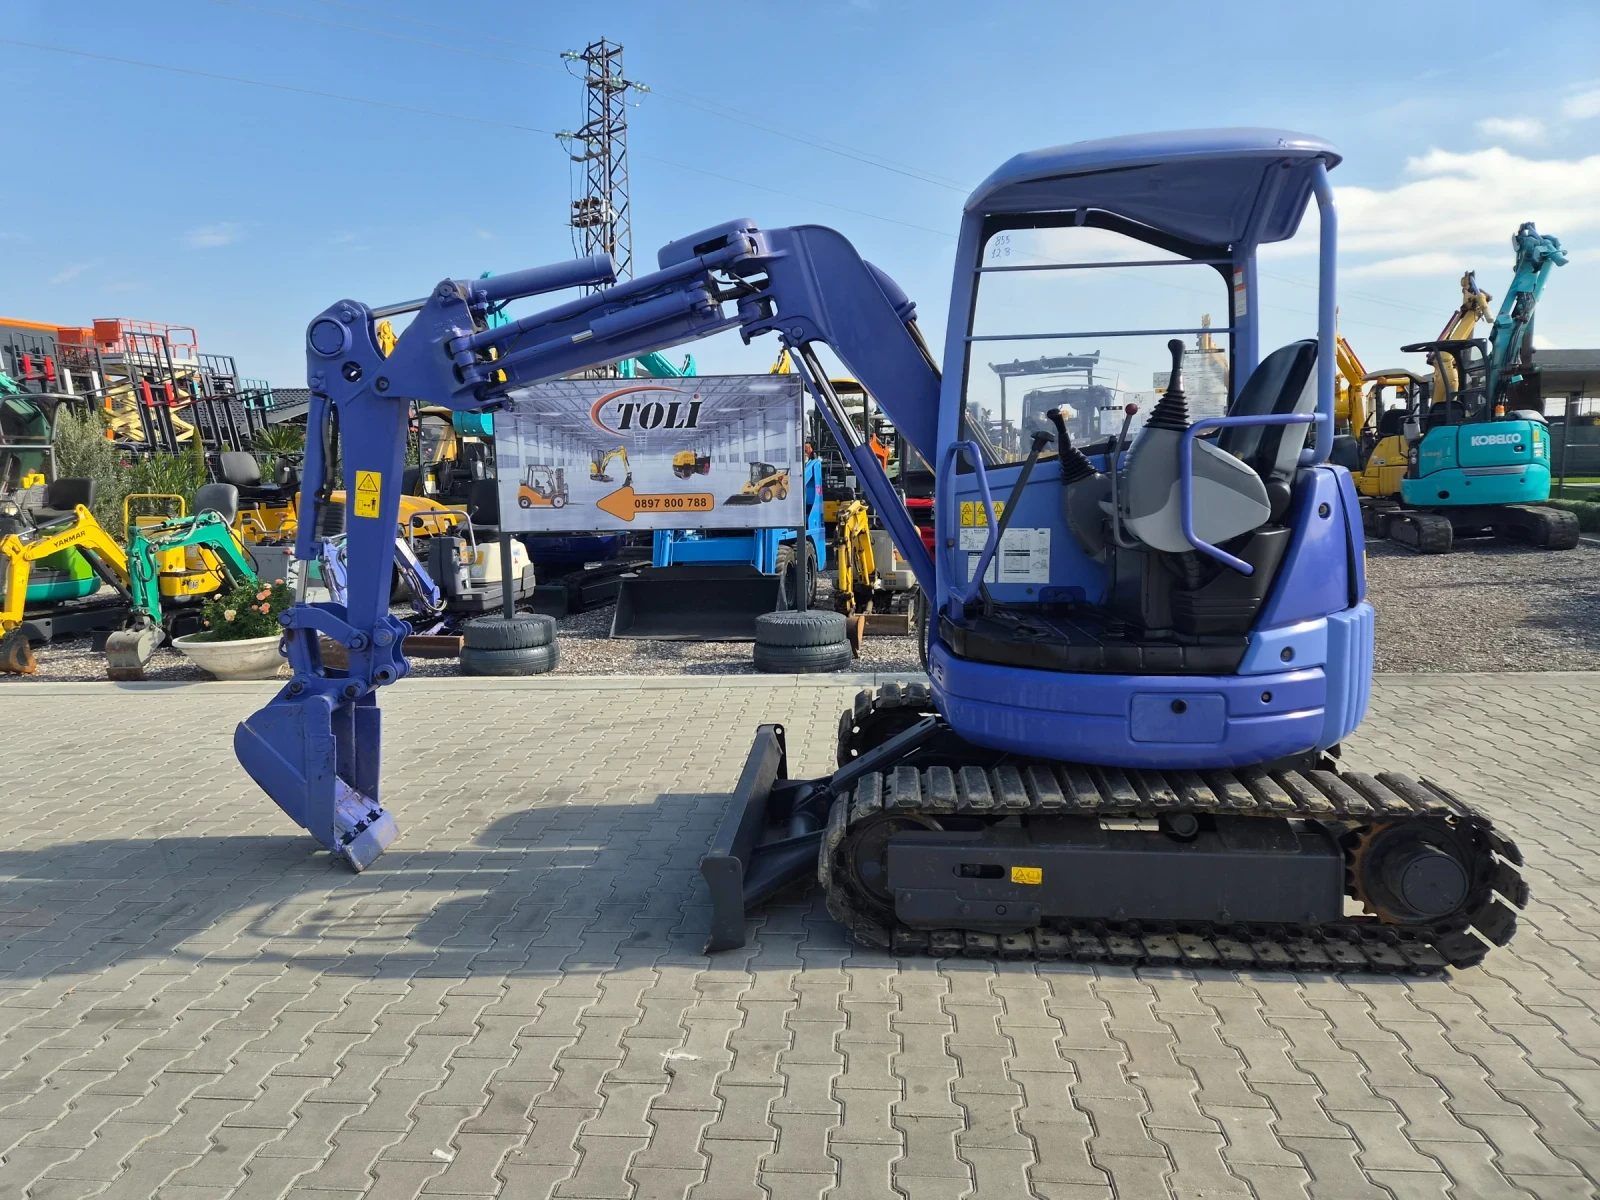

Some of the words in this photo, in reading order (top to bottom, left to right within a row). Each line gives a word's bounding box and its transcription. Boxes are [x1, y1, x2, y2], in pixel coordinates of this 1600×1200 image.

[995, 235, 1011, 246] 855
[1471, 433, 1522, 447] KOBELCO
[634, 498, 660, 508] 0897
[664, 498, 684, 508] 800
[687, 497, 707, 508] 788
[53, 530, 86, 548] YANMAR
